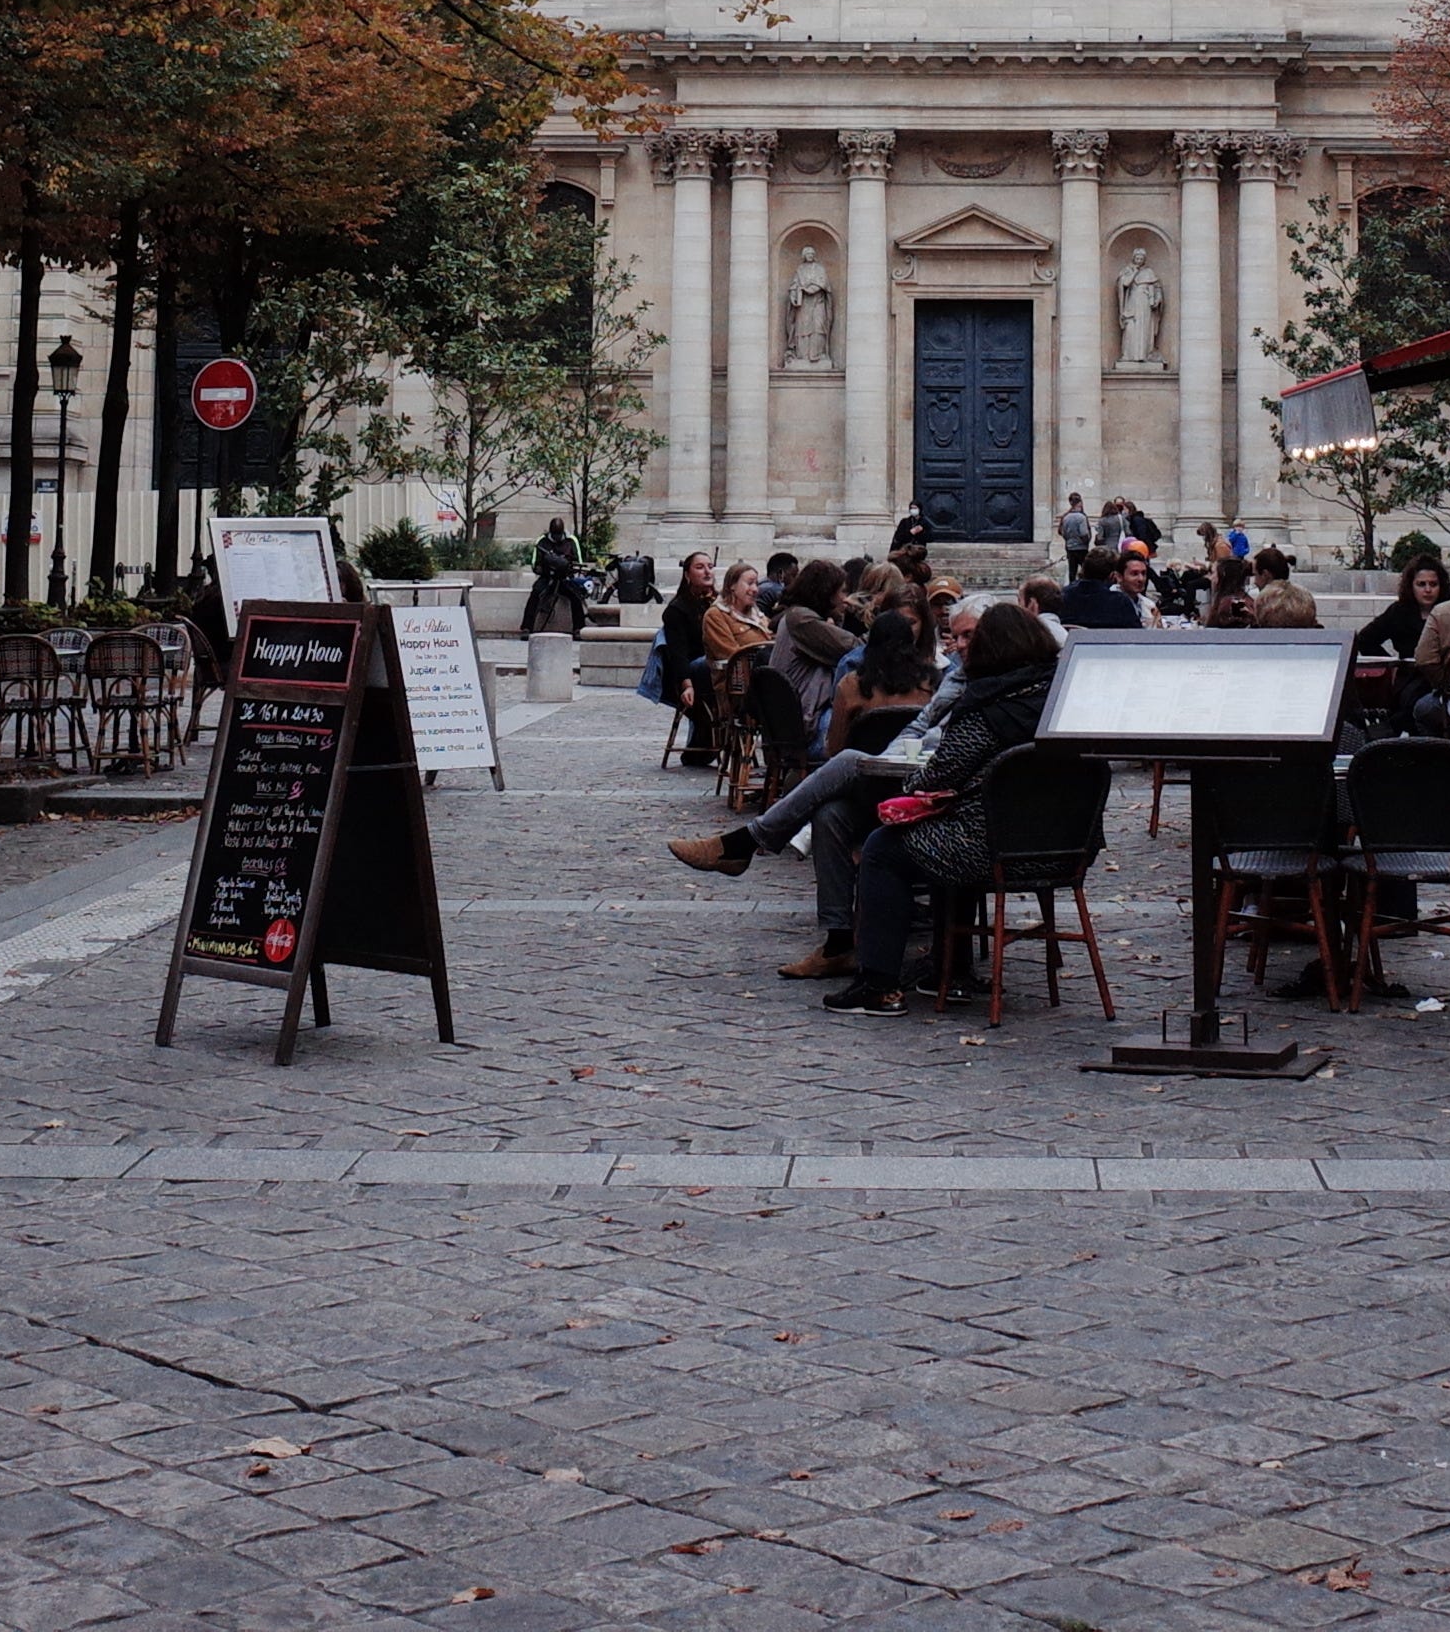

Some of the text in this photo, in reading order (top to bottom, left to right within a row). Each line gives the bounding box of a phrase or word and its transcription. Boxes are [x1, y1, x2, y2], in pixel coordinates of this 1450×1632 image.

[403, 618, 452, 633] Les Patios
[399, 638, 430, 651] Happy
[253, 637, 343, 668] Happy Hour
